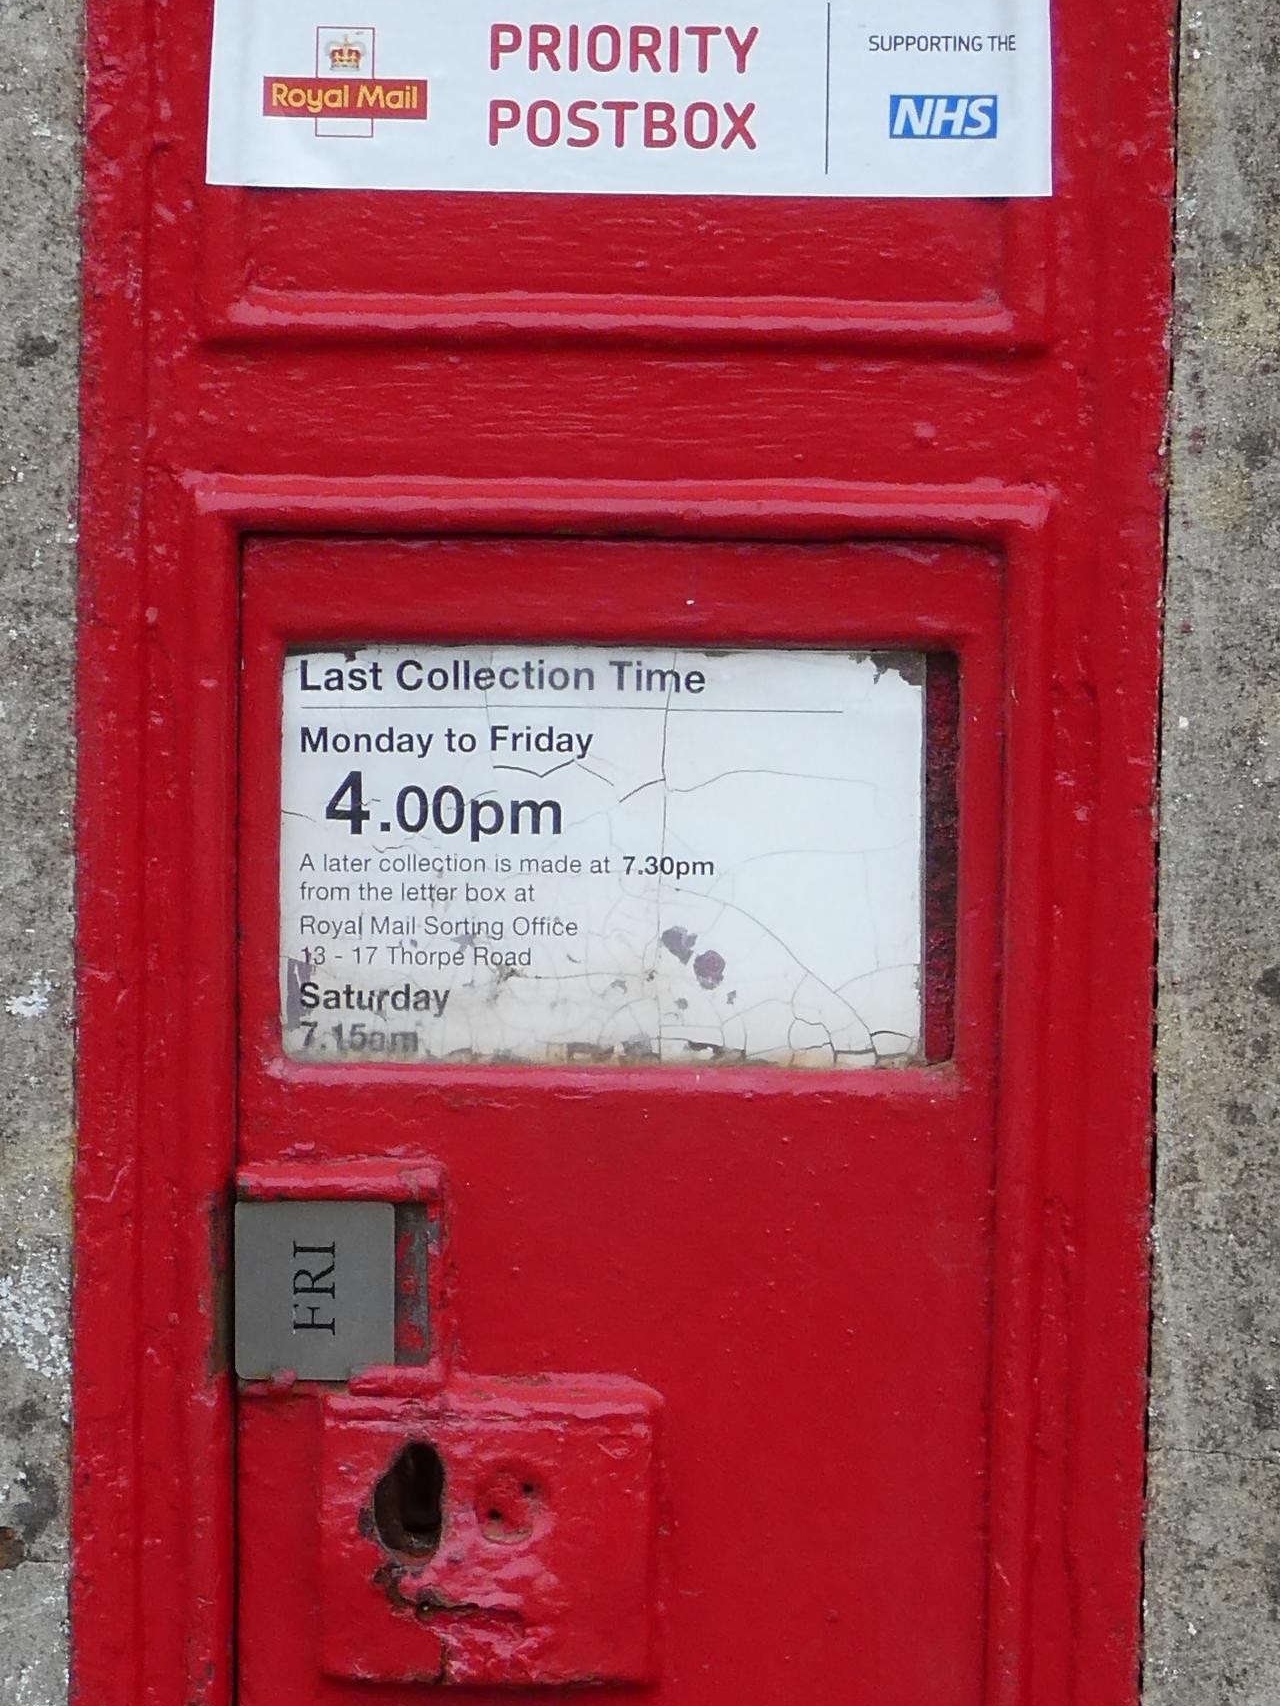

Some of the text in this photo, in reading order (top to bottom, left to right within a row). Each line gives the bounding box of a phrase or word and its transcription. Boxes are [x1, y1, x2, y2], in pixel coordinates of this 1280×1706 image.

[489, 23, 760, 75] PRIORITY
[868, 34, 1017, 52] SUPPORTING THE
[271, 82, 418, 114] Royal Mail
[488, 99, 758, 151] POSTBOX
[893, 98, 995, 136] NHS
[300, 659, 706, 694] Last Collection Time
[300, 725, 593, 760] Monday to Friday
[325, 769, 562, 842] 4.00pm
[299, 853, 714, 880] A later collection is made at 7.30pm
[300, 880, 535, 902] from the letter box at
[300, 915, 578, 940] Royal Mail Sorting Office
[301, 946, 326, 966] 13
[352, 946, 378, 965] 17
[389, 946, 465, 970] Thorpe
[473, 946, 531, 967] Road
[299, 981, 451, 1018] Saturday
[299, 1020, 419, 1052] 7.15am
[291, 1239, 337, 1336] FRI
